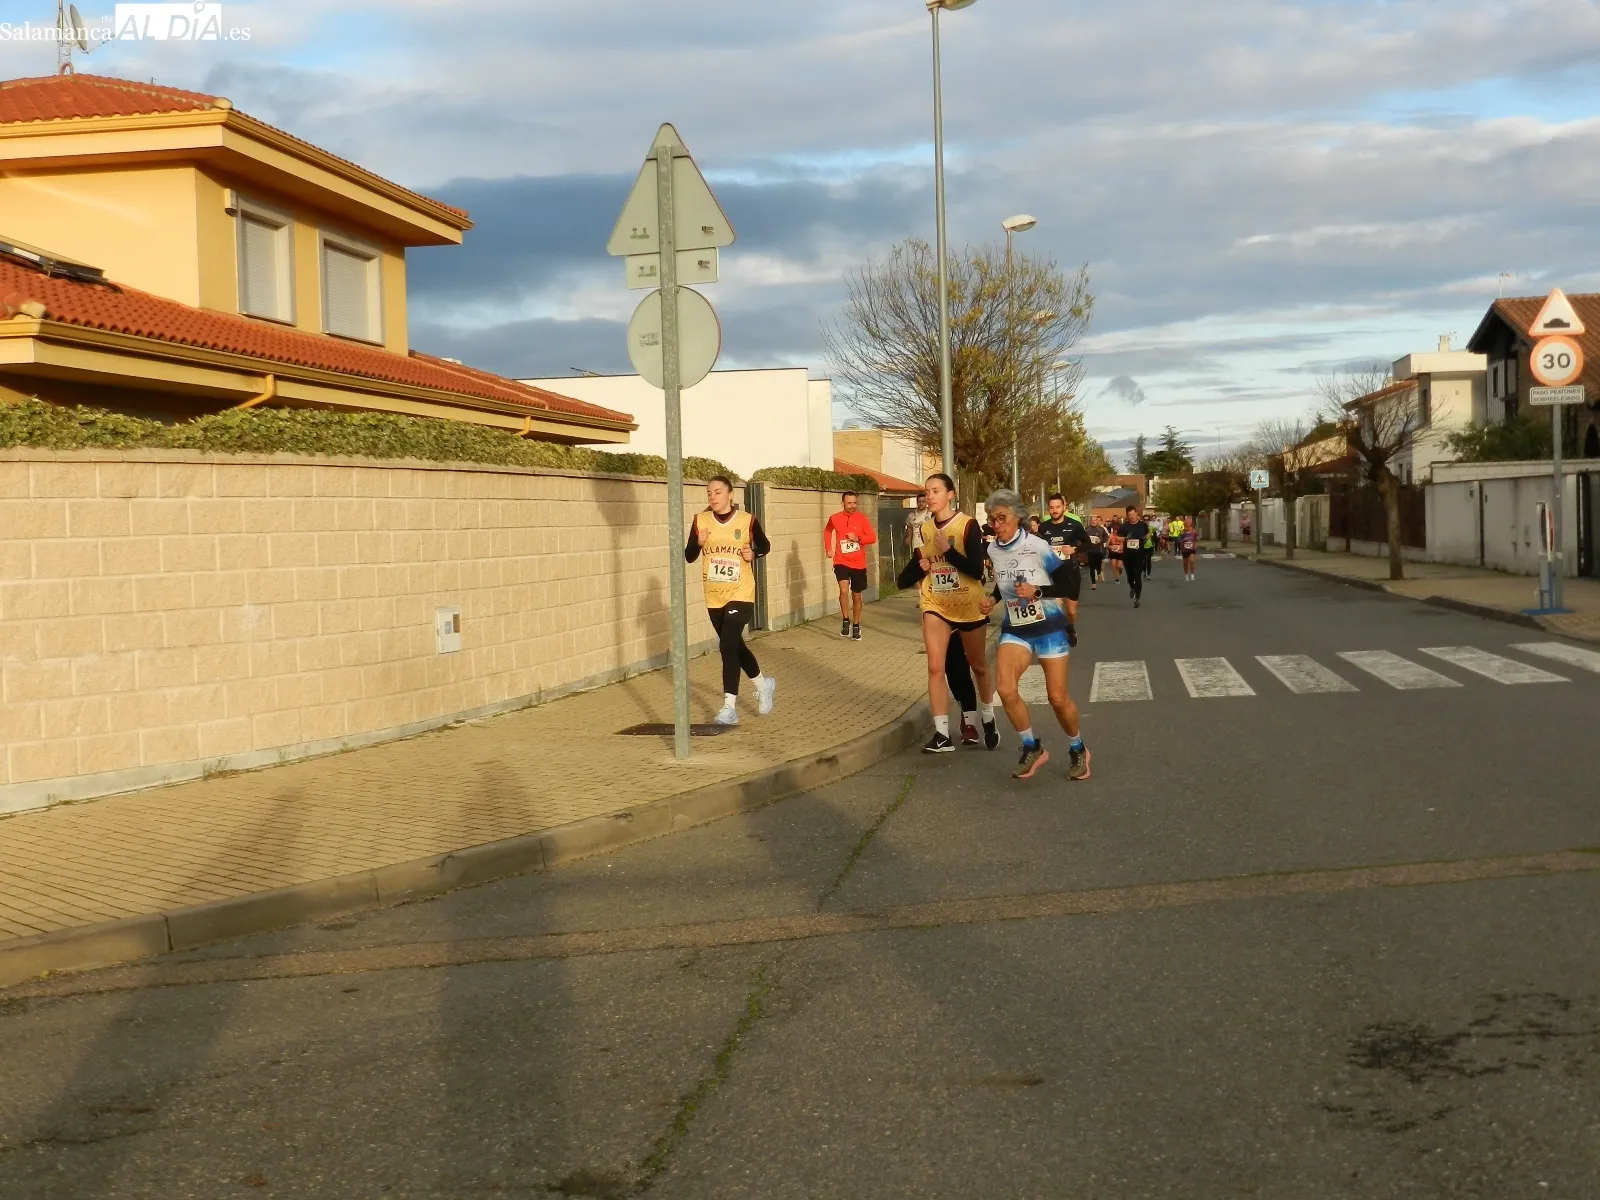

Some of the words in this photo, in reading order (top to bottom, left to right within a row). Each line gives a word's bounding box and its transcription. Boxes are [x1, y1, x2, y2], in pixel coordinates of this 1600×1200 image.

[1543, 353, 1571, 369] 30
[714, 564, 735, 577] 145
[935, 573, 955, 585] 134
[1014, 604, 1037, 619] 188
